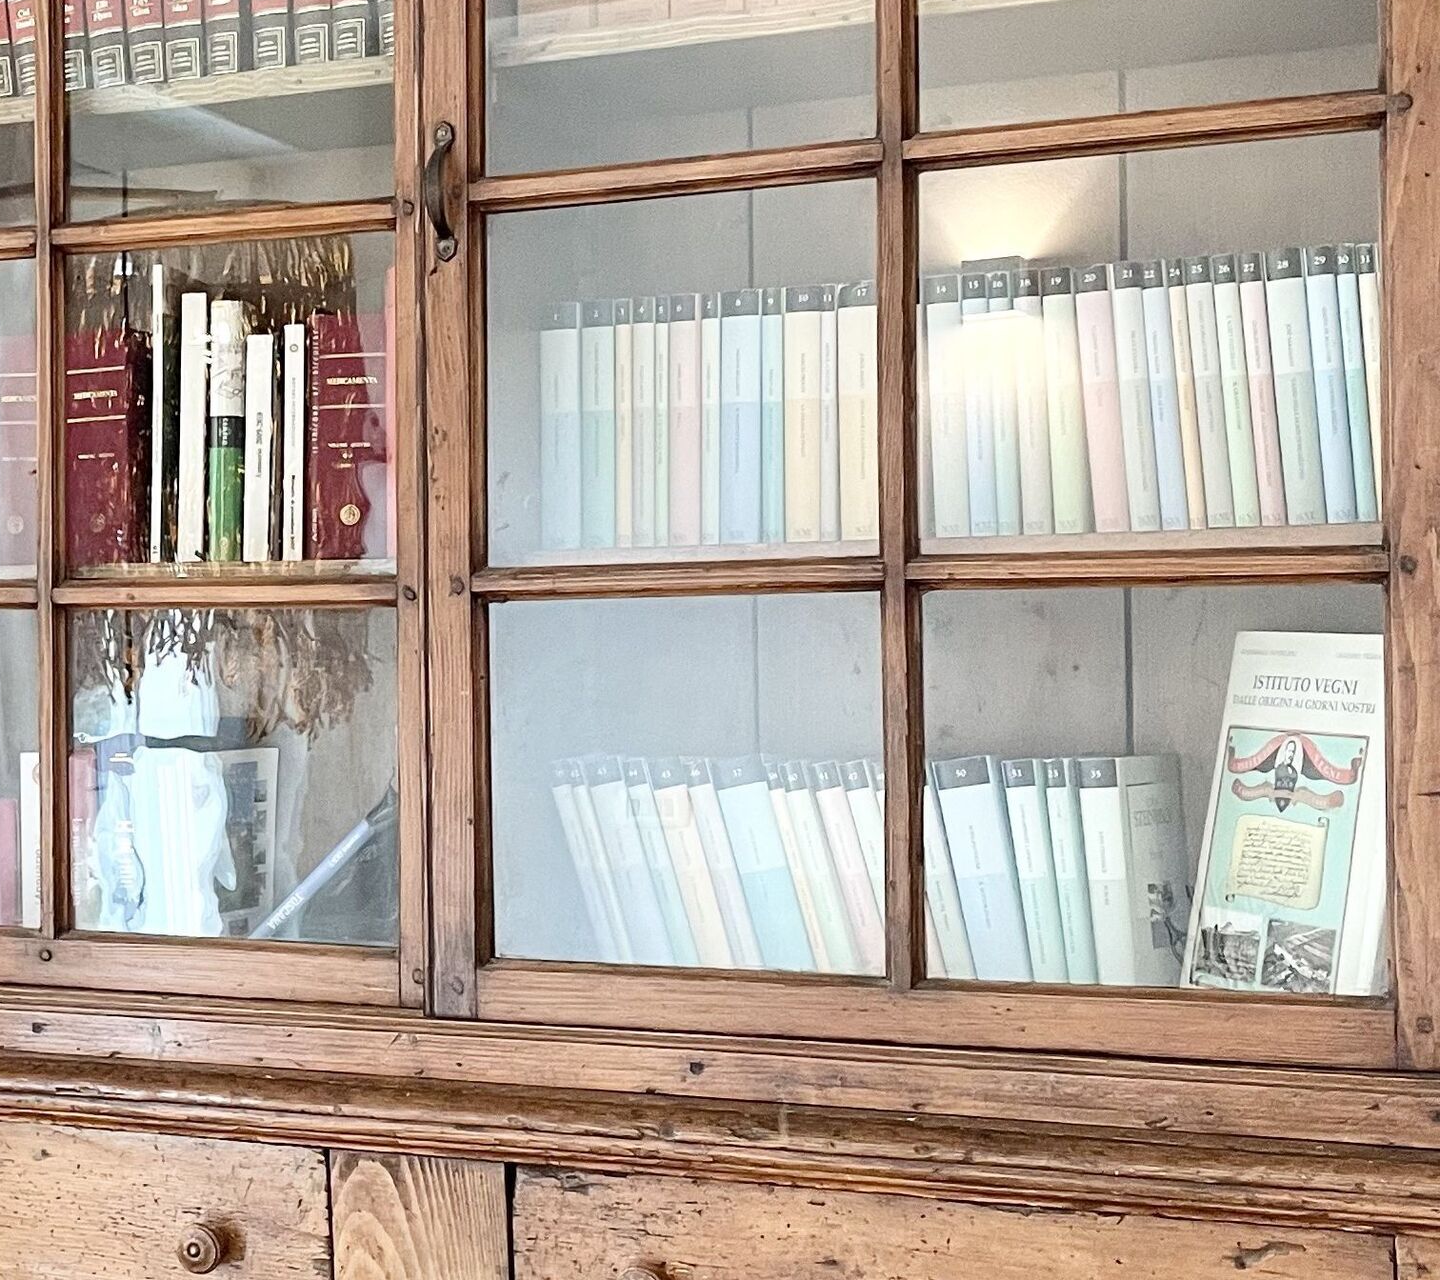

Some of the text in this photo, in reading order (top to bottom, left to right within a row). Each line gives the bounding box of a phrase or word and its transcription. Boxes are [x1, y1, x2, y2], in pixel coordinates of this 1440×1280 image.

[1252, 674, 1359, 696] ISTITUTO VEGNI
[1232, 694, 1376, 715] DALLE ORIGINI AI GIORNI NOSTRI
[266, 893, 305, 930] TOSCANA
